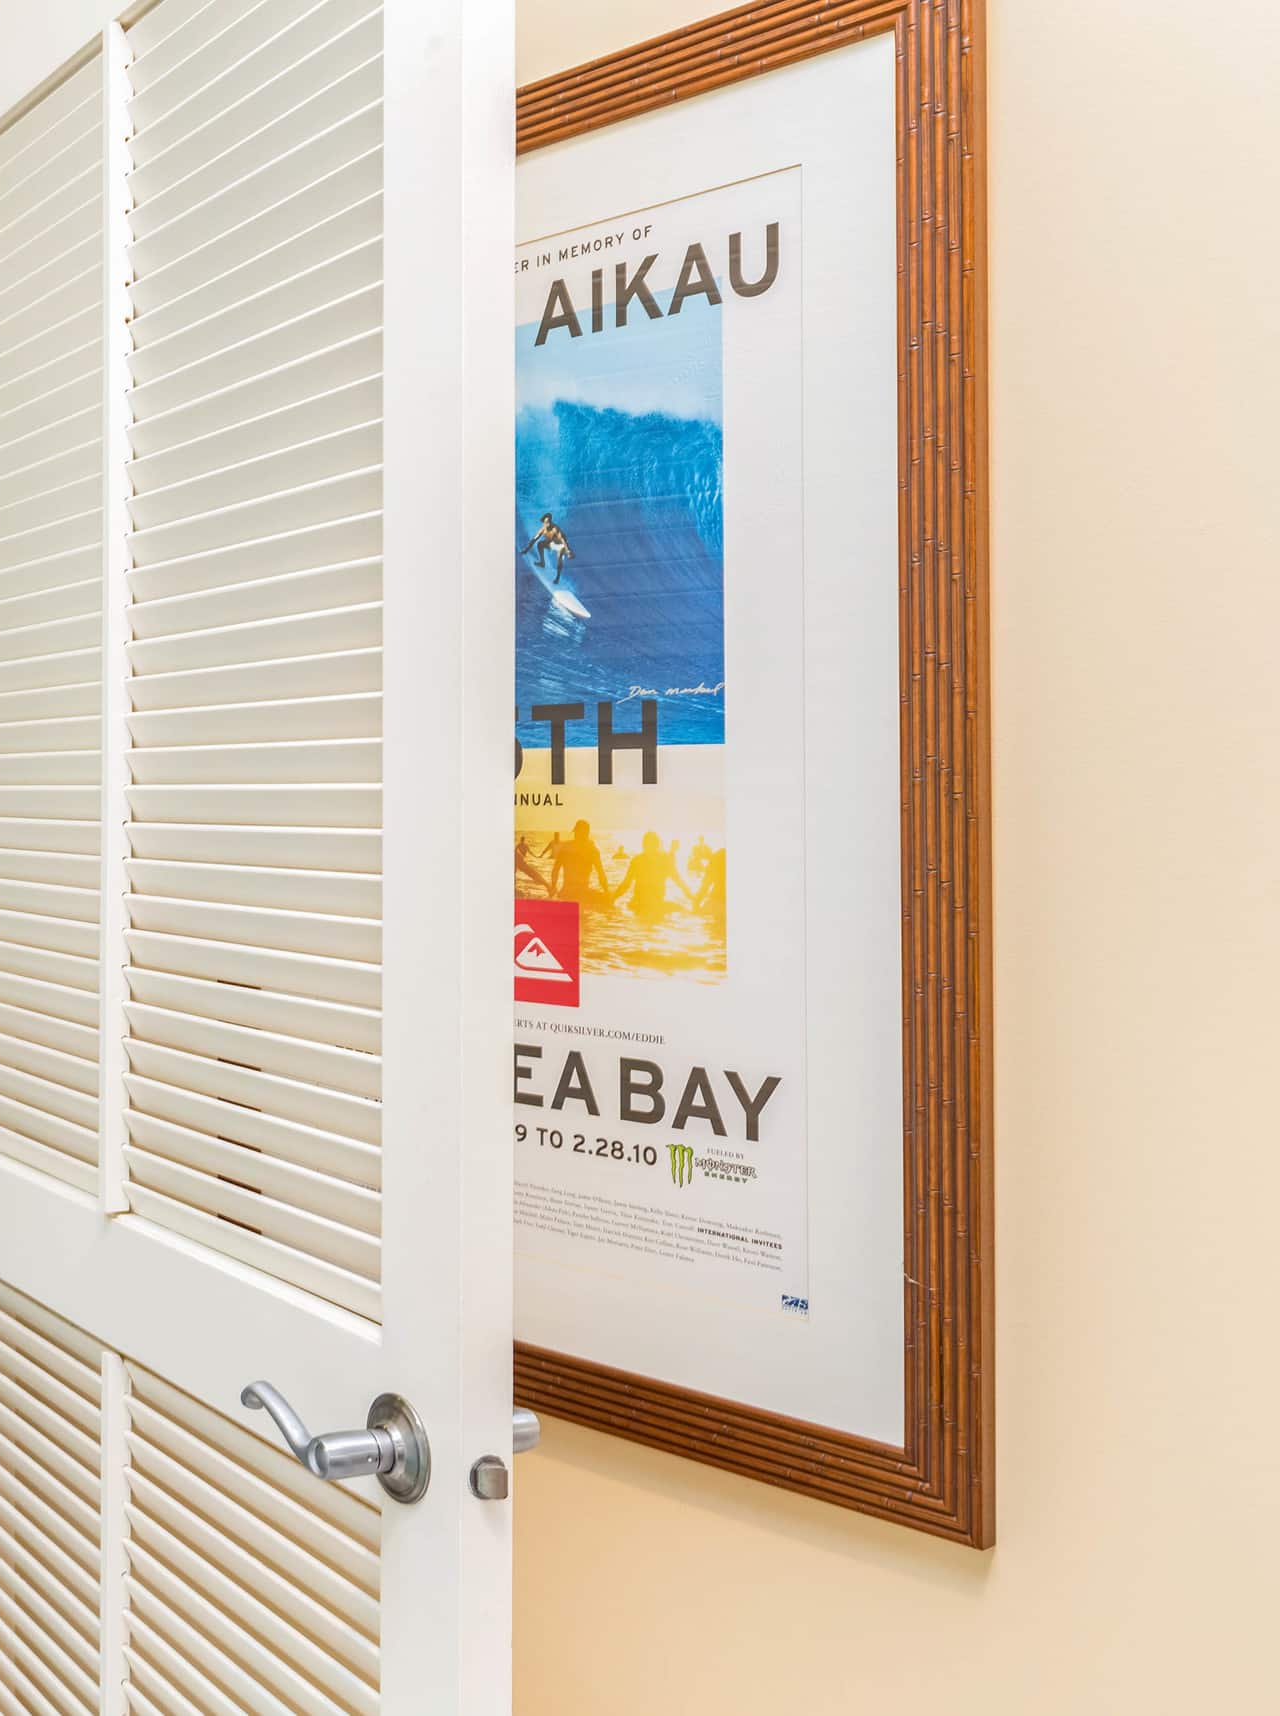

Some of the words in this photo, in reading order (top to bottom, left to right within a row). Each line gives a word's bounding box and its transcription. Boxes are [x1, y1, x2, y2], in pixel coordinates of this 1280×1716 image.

[536, 252, 551, 267] IN
[559, 232, 624, 262] MEMORY
[632, 225, 652, 241] OF
[534, 222, 780, 347] AIKAU
[515, 699, 657, 785] TH
[514, 792, 564, 806] NUAL
[535, 1020, 549, 1031] AT
[550, 1022, 666, 1045] QUIKSILVER.COM/EDDIE
[514, 1043, 601, 1117] EA
[619, 1056, 783, 1142] BAY
[514, 1124, 528, 1142] 9
[536, 1127, 563, 1149] TO
[572, 1134, 658, 1166] 2.28.10
[697, 1227, 750, 1244] INTERNATIONAL
[751, 1238, 783, 1250] INVITEES
